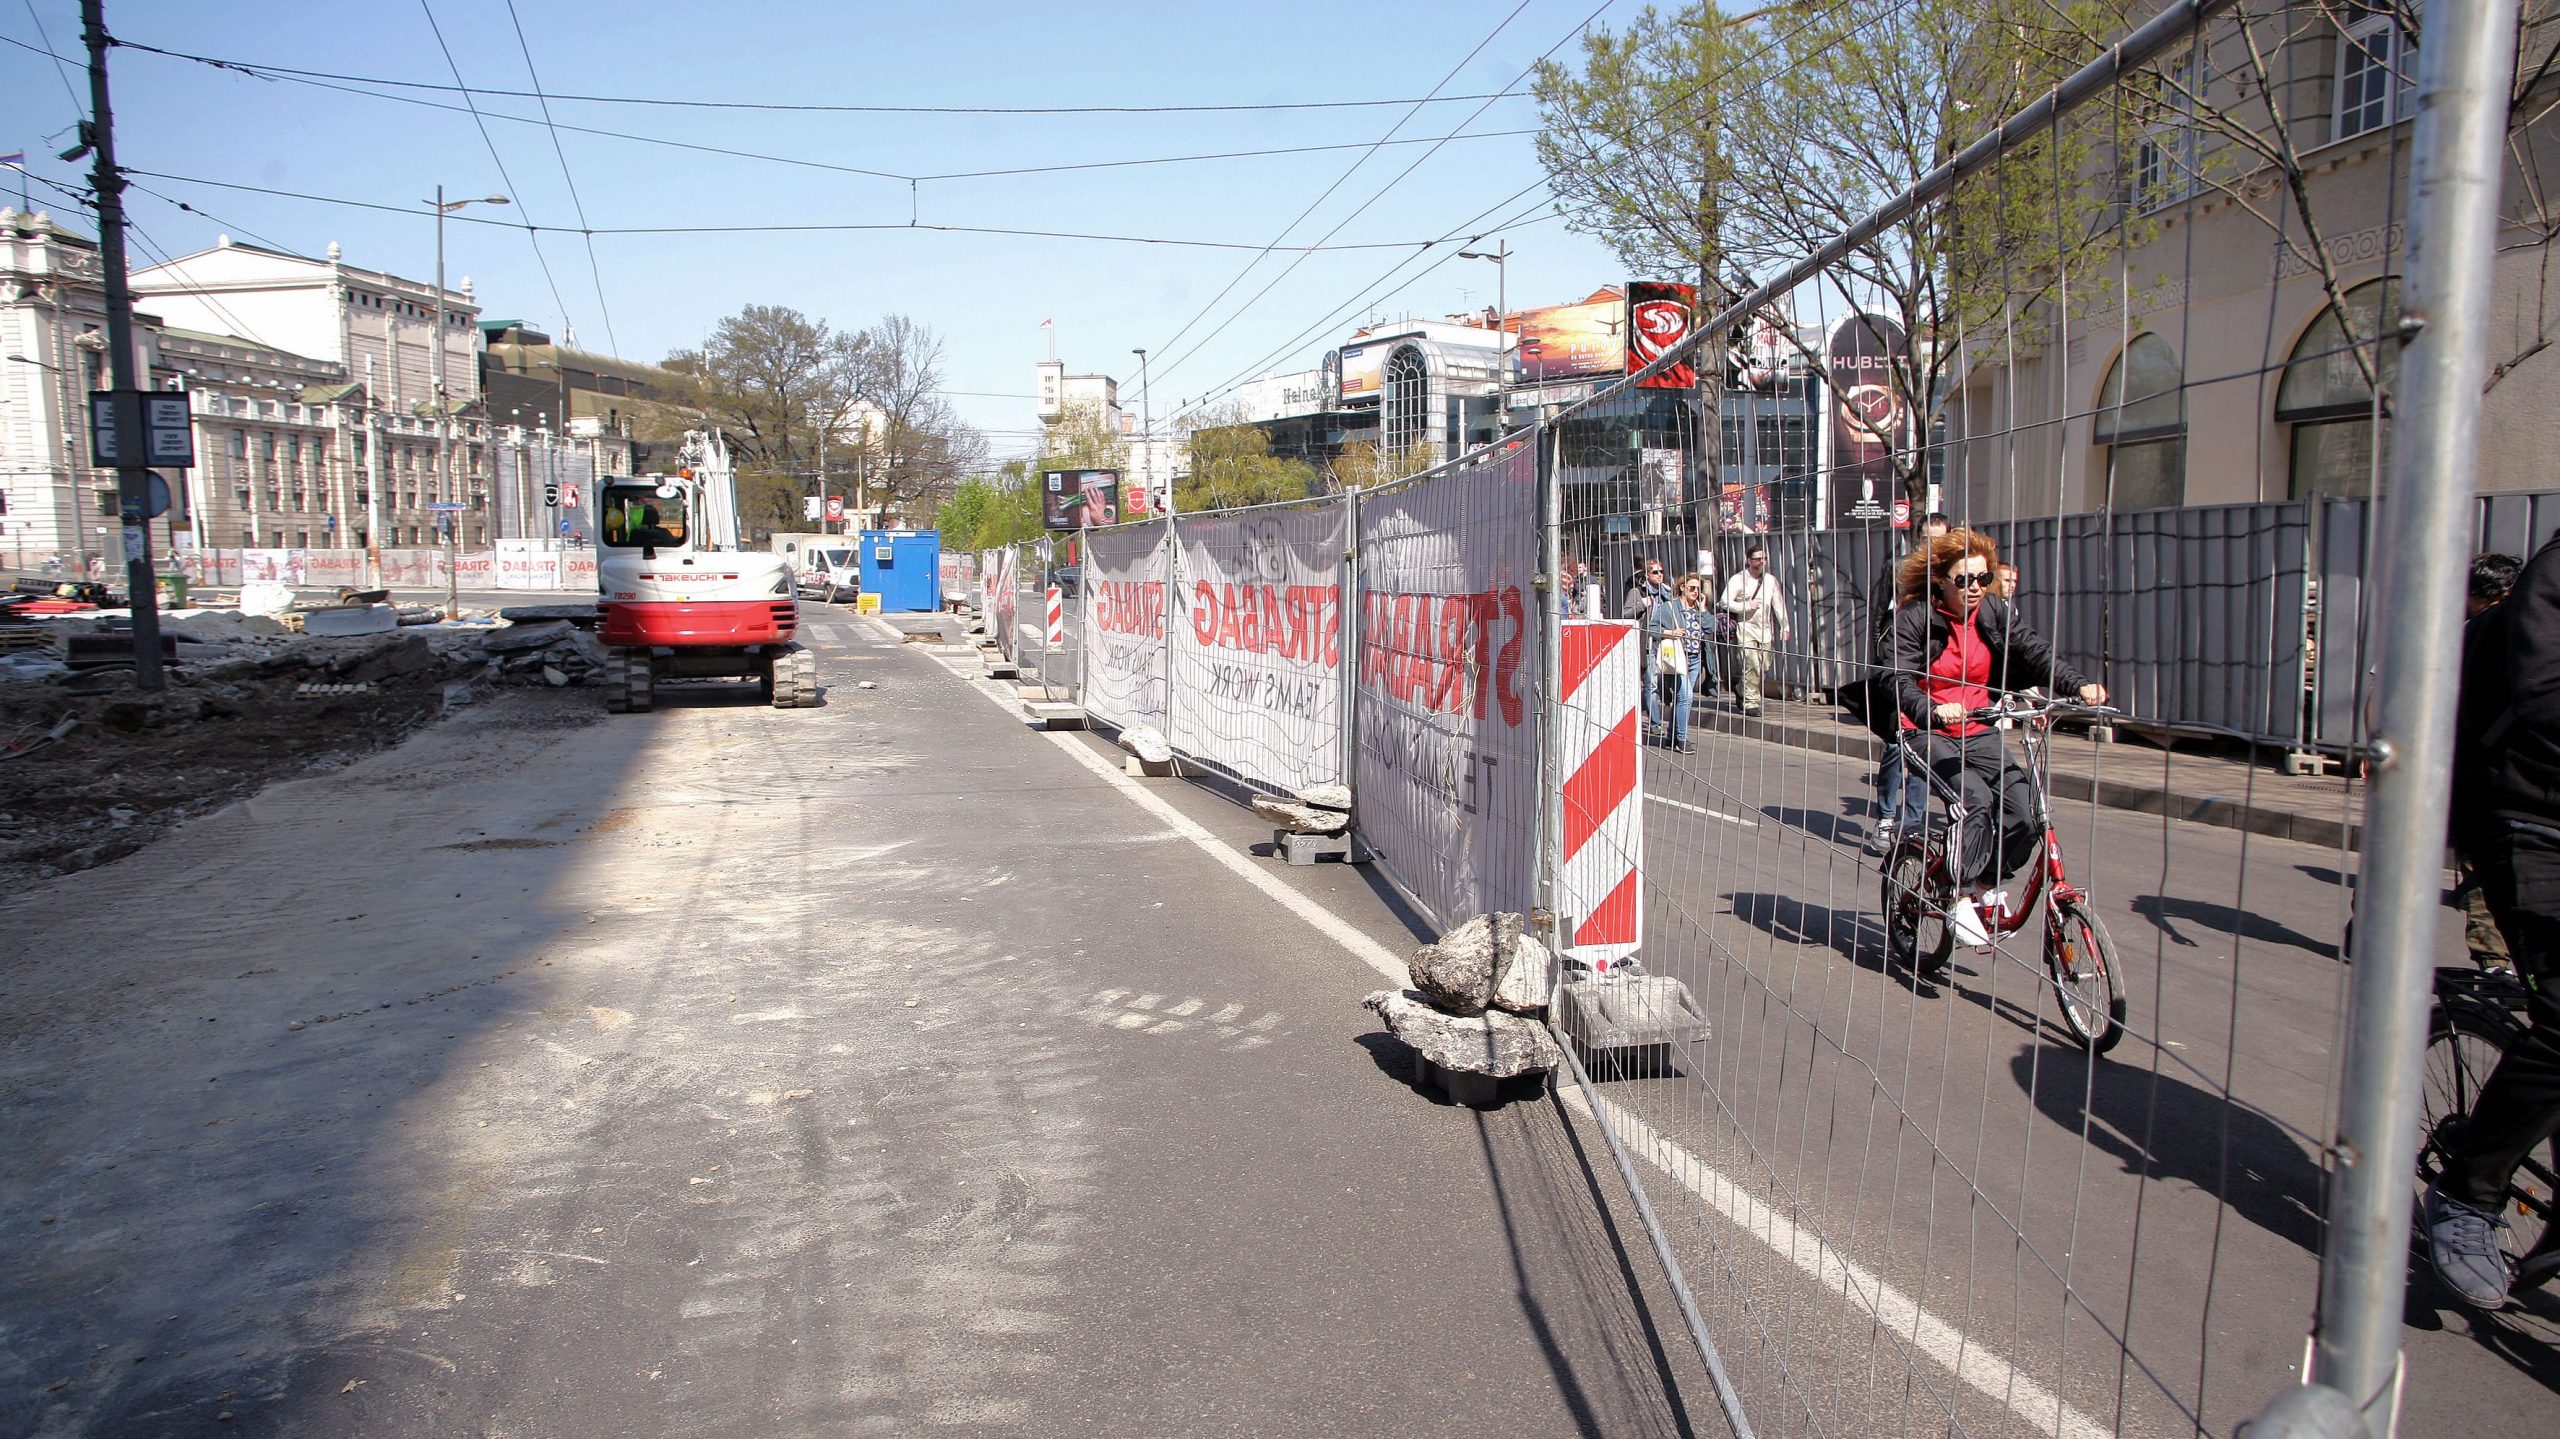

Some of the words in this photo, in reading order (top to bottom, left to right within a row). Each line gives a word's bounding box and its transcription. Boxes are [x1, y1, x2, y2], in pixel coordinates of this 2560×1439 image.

[1833, 355, 1910, 369] HUBLT
[1283, 384, 1339, 405] Heineken
[614, 592, 637, 600] TB290
